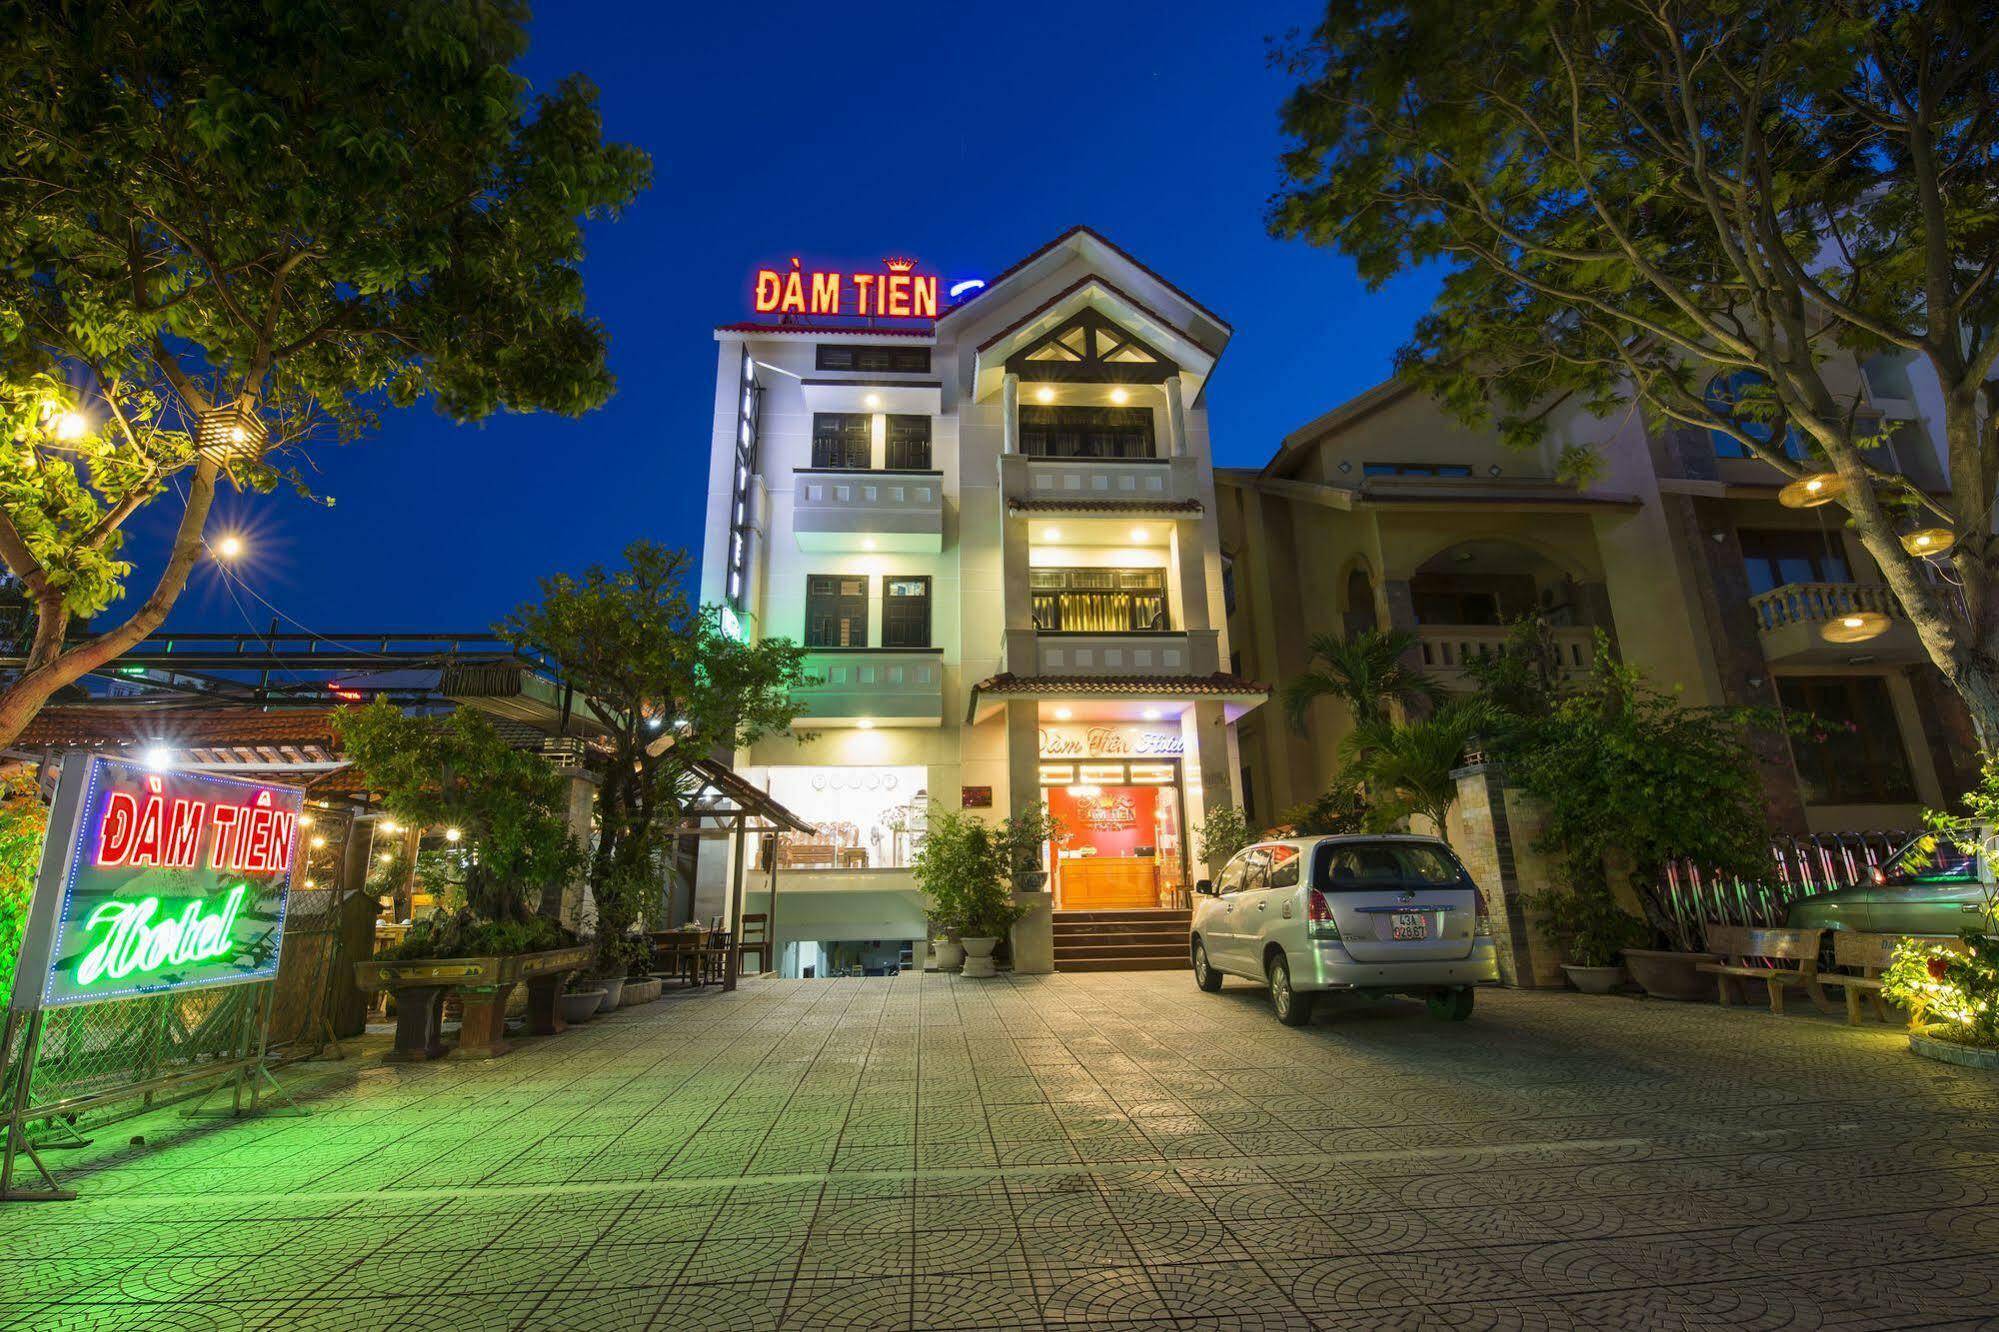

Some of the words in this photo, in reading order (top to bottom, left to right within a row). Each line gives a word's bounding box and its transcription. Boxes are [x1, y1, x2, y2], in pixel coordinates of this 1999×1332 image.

[755, 257, 841, 315] ĐÀM
[97, 776, 206, 869] ĐÀM
[212, 790, 296, 871] TIÊN
[76, 883, 247, 986] Hotel
[1400, 914, 1418, 926] 43A
